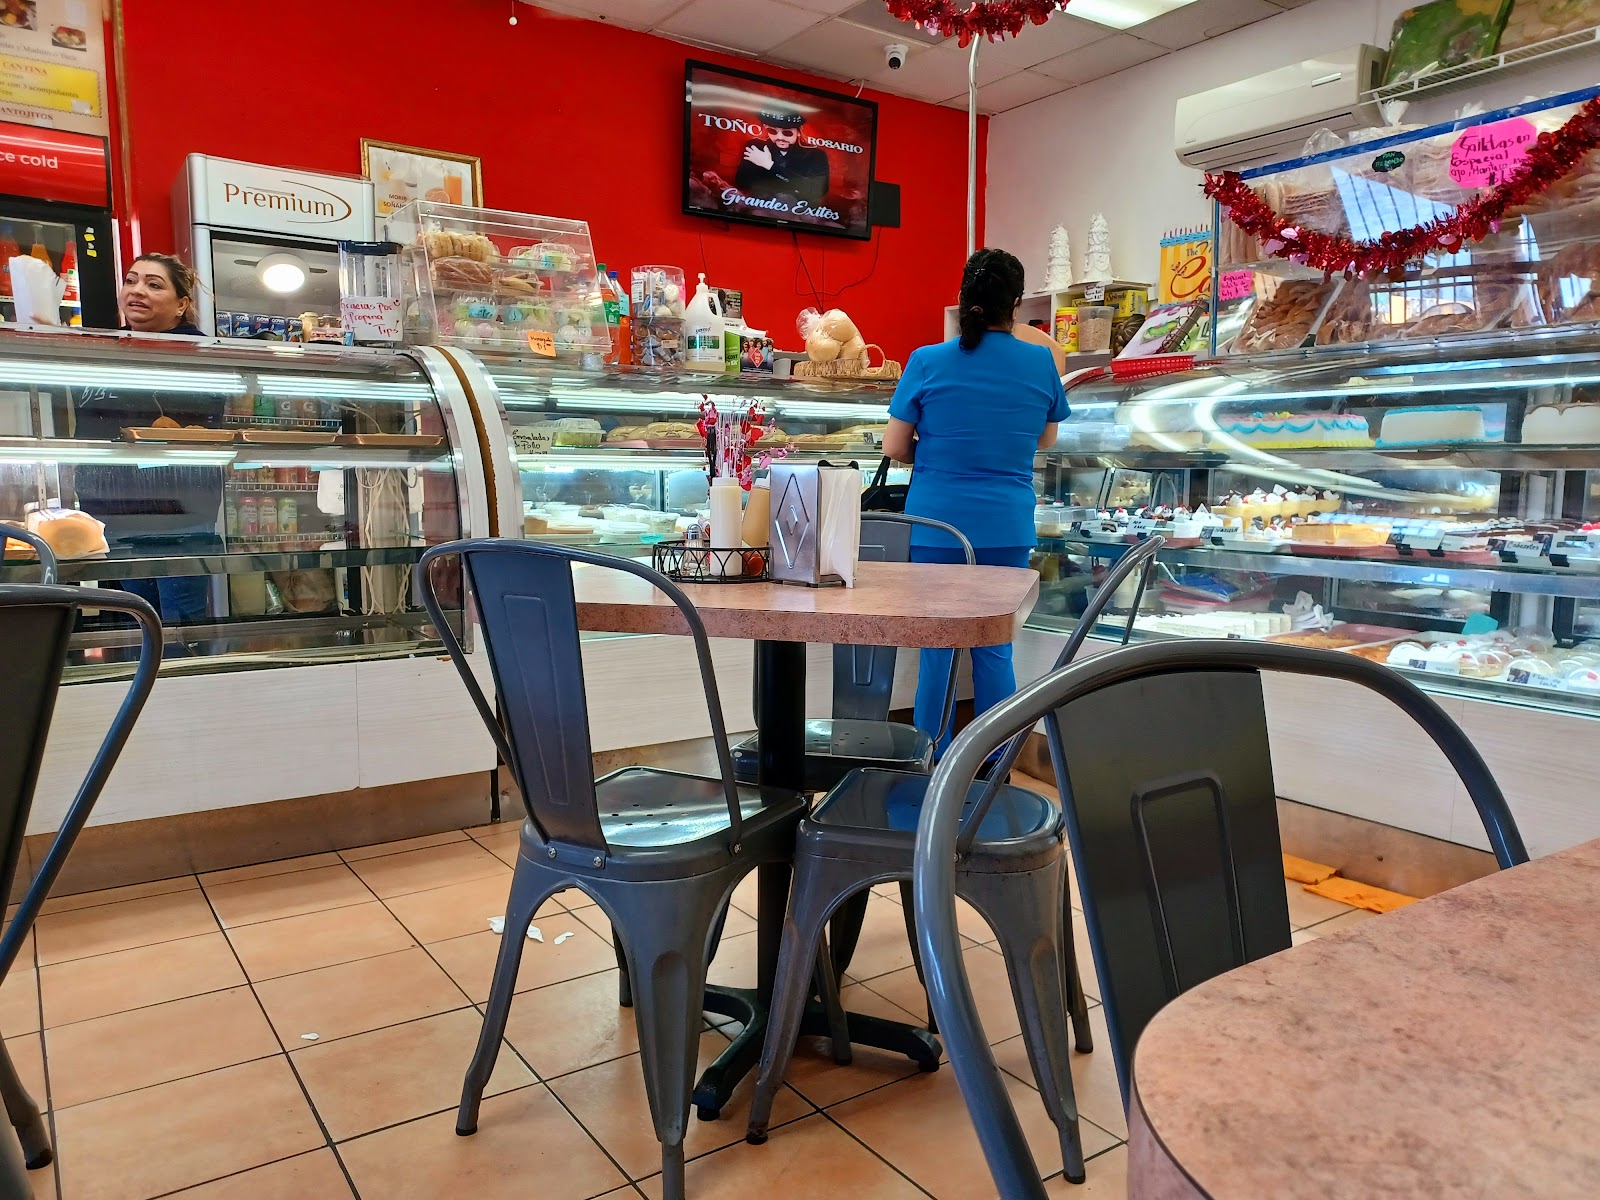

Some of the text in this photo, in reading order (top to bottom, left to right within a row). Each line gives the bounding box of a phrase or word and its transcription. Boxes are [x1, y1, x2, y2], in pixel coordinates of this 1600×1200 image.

[806, 136, 864, 154] ROSARIO
[20, 154, 58, 169] cold
[223, 182, 334, 217] Premium
[721, 188, 789, 212] Grandes
[1186, 248, 1199, 257] The
[348, 312, 384, 325] Propina
